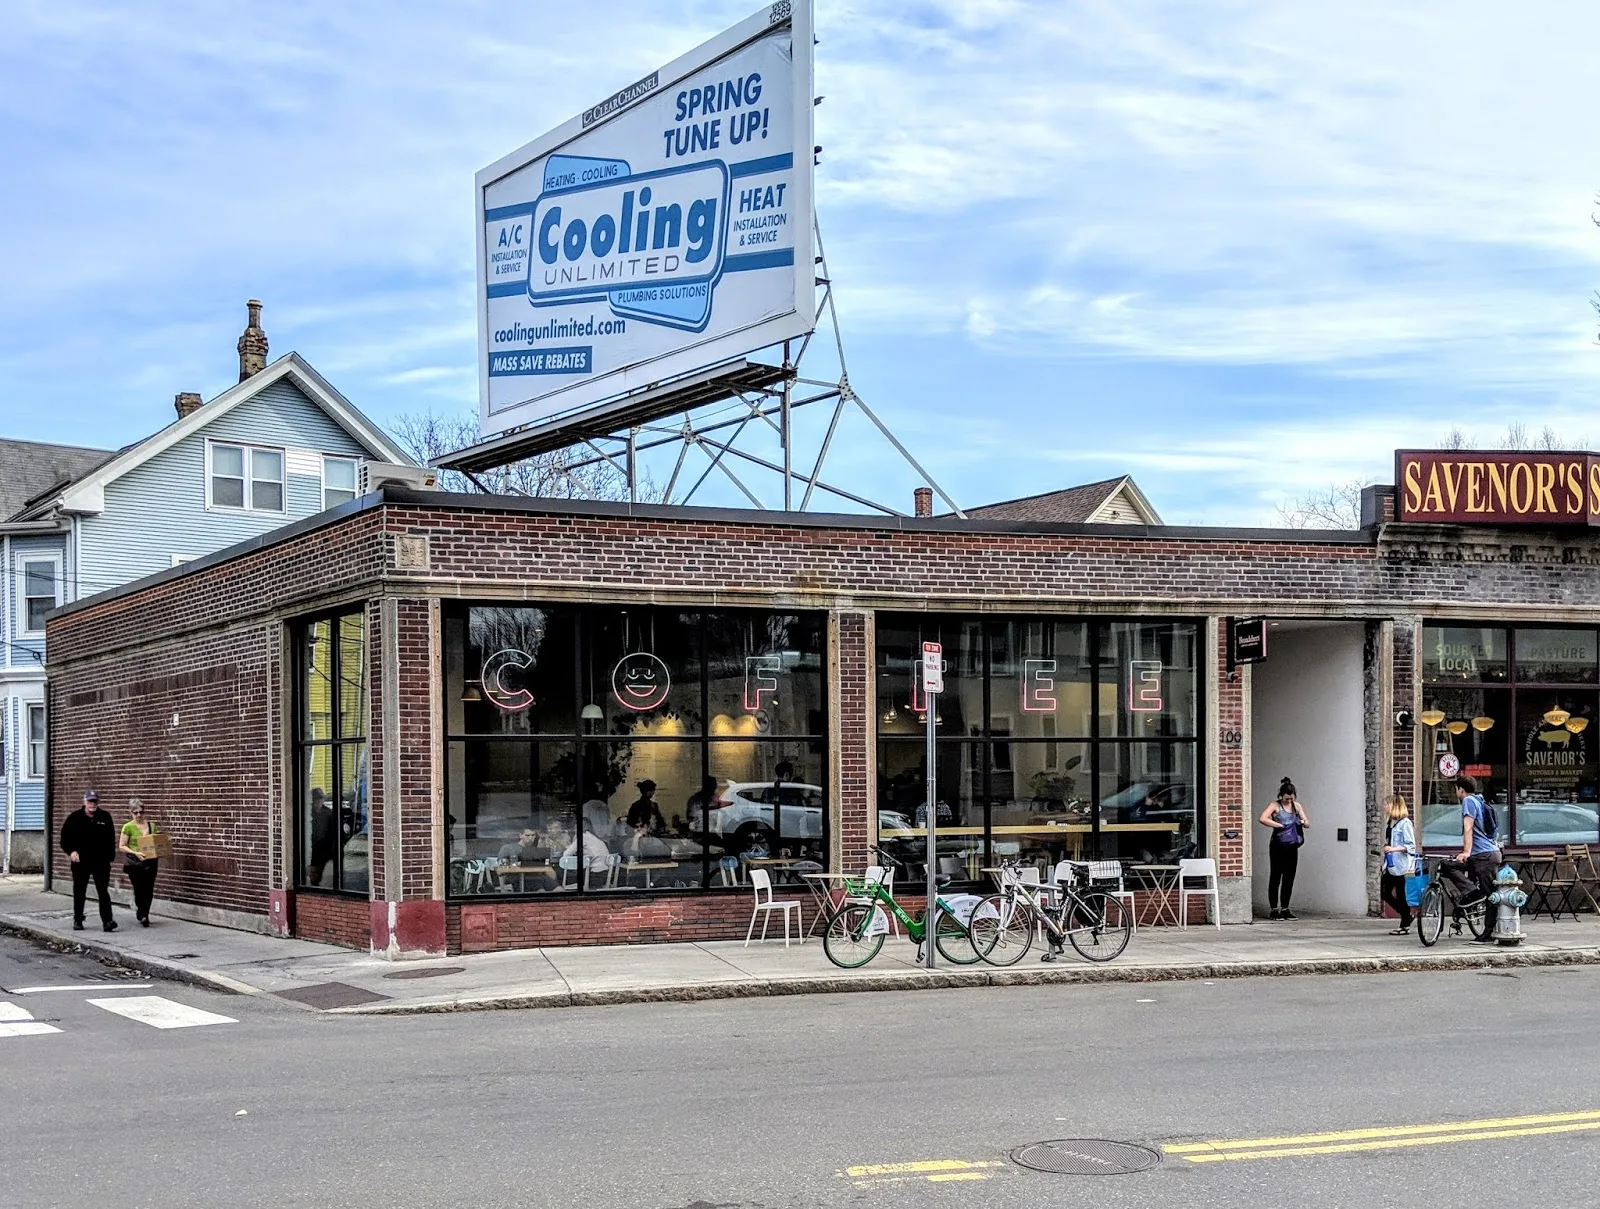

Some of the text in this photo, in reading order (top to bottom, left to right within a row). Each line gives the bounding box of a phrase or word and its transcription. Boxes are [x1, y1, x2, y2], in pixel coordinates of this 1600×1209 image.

[769, 3, 791, 24] 12569
[675, 72, 762, 122] SPRING
[664, 107, 769, 158] TUNE UP!
[545, 164, 618, 189] HEATING COOLING
[739, 182, 786, 213] HEAT
[538, 186, 717, 265] Cooling
[733, 213, 787, 232] INSTALLATION
[498, 224, 523, 248] A/C
[739, 230, 778, 247] & SERVICE
[491, 249, 528, 263] INSTALLATION
[496, 261, 521, 275] & SERVICE
[544, 255, 680, 285] UNLIMITED
[617, 284, 707, 304] PLUMBING SOLUTIONS
[494, 314, 626, 345] coolingunlimited.com
[492, 352, 586, 372] MASS SAVE REBATES
[1404, 461, 1584, 514] SAVENOR'S
[1526, 751, 1586, 765] SAVENOR'S
